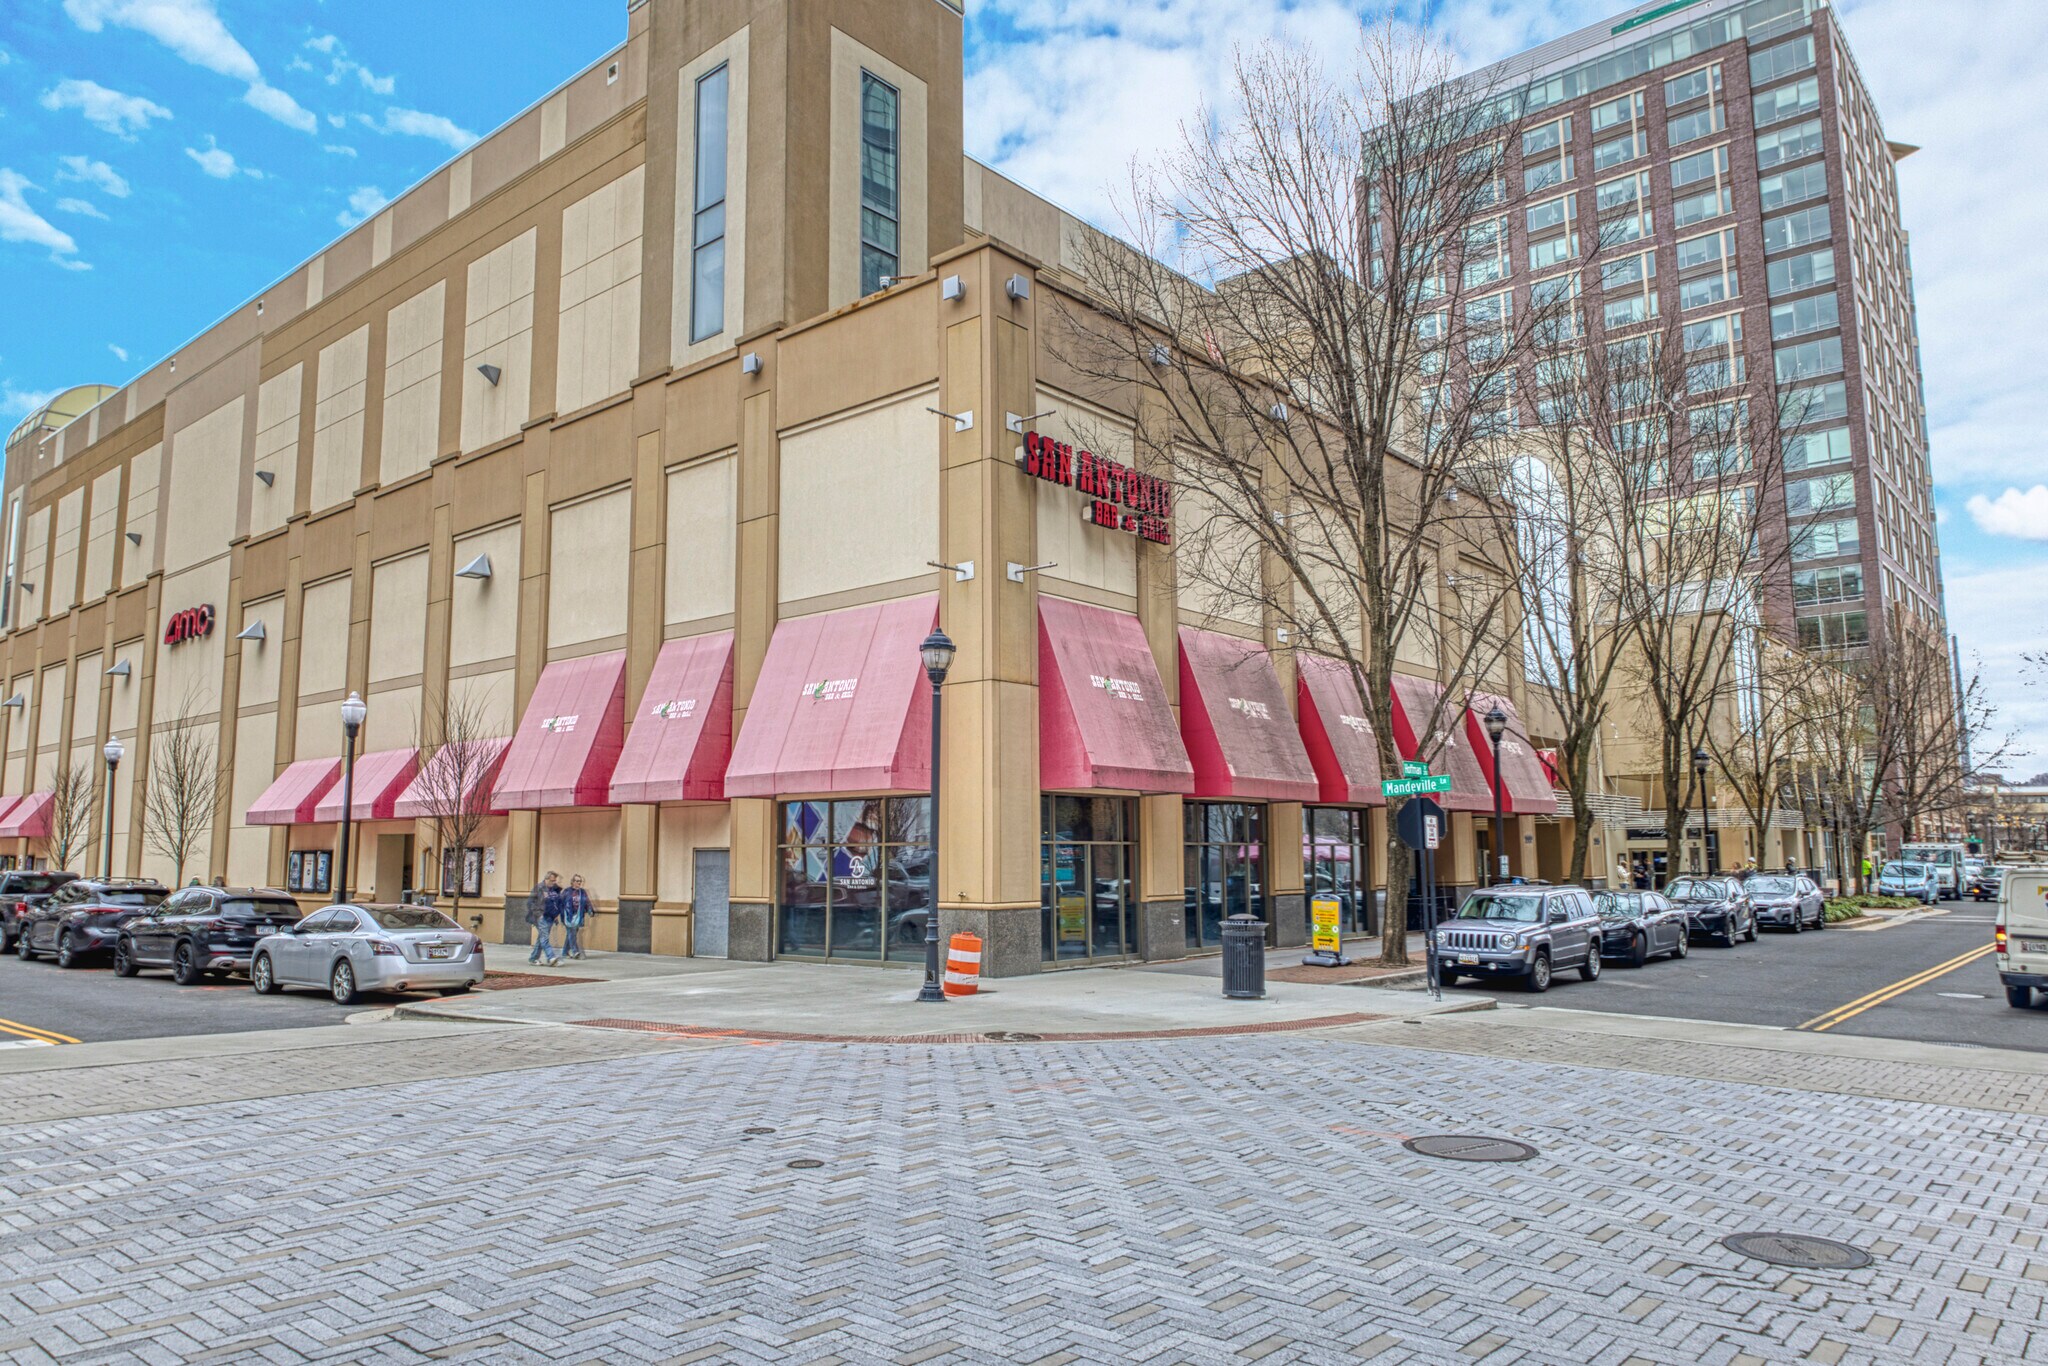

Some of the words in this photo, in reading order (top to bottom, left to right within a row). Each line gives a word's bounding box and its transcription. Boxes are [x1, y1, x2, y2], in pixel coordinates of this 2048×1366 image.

[1023, 430, 1073, 488] SAN
[1077, 450, 1172, 518] ANTONIO
[1091, 500, 1119, 530] BAR
[1121, 514, 1137, 532] &
[802, 682, 820, 696] SAN
[822, 678, 858, 694] ANTONIO
[1386, 780, 1436, 794] Mandeville
